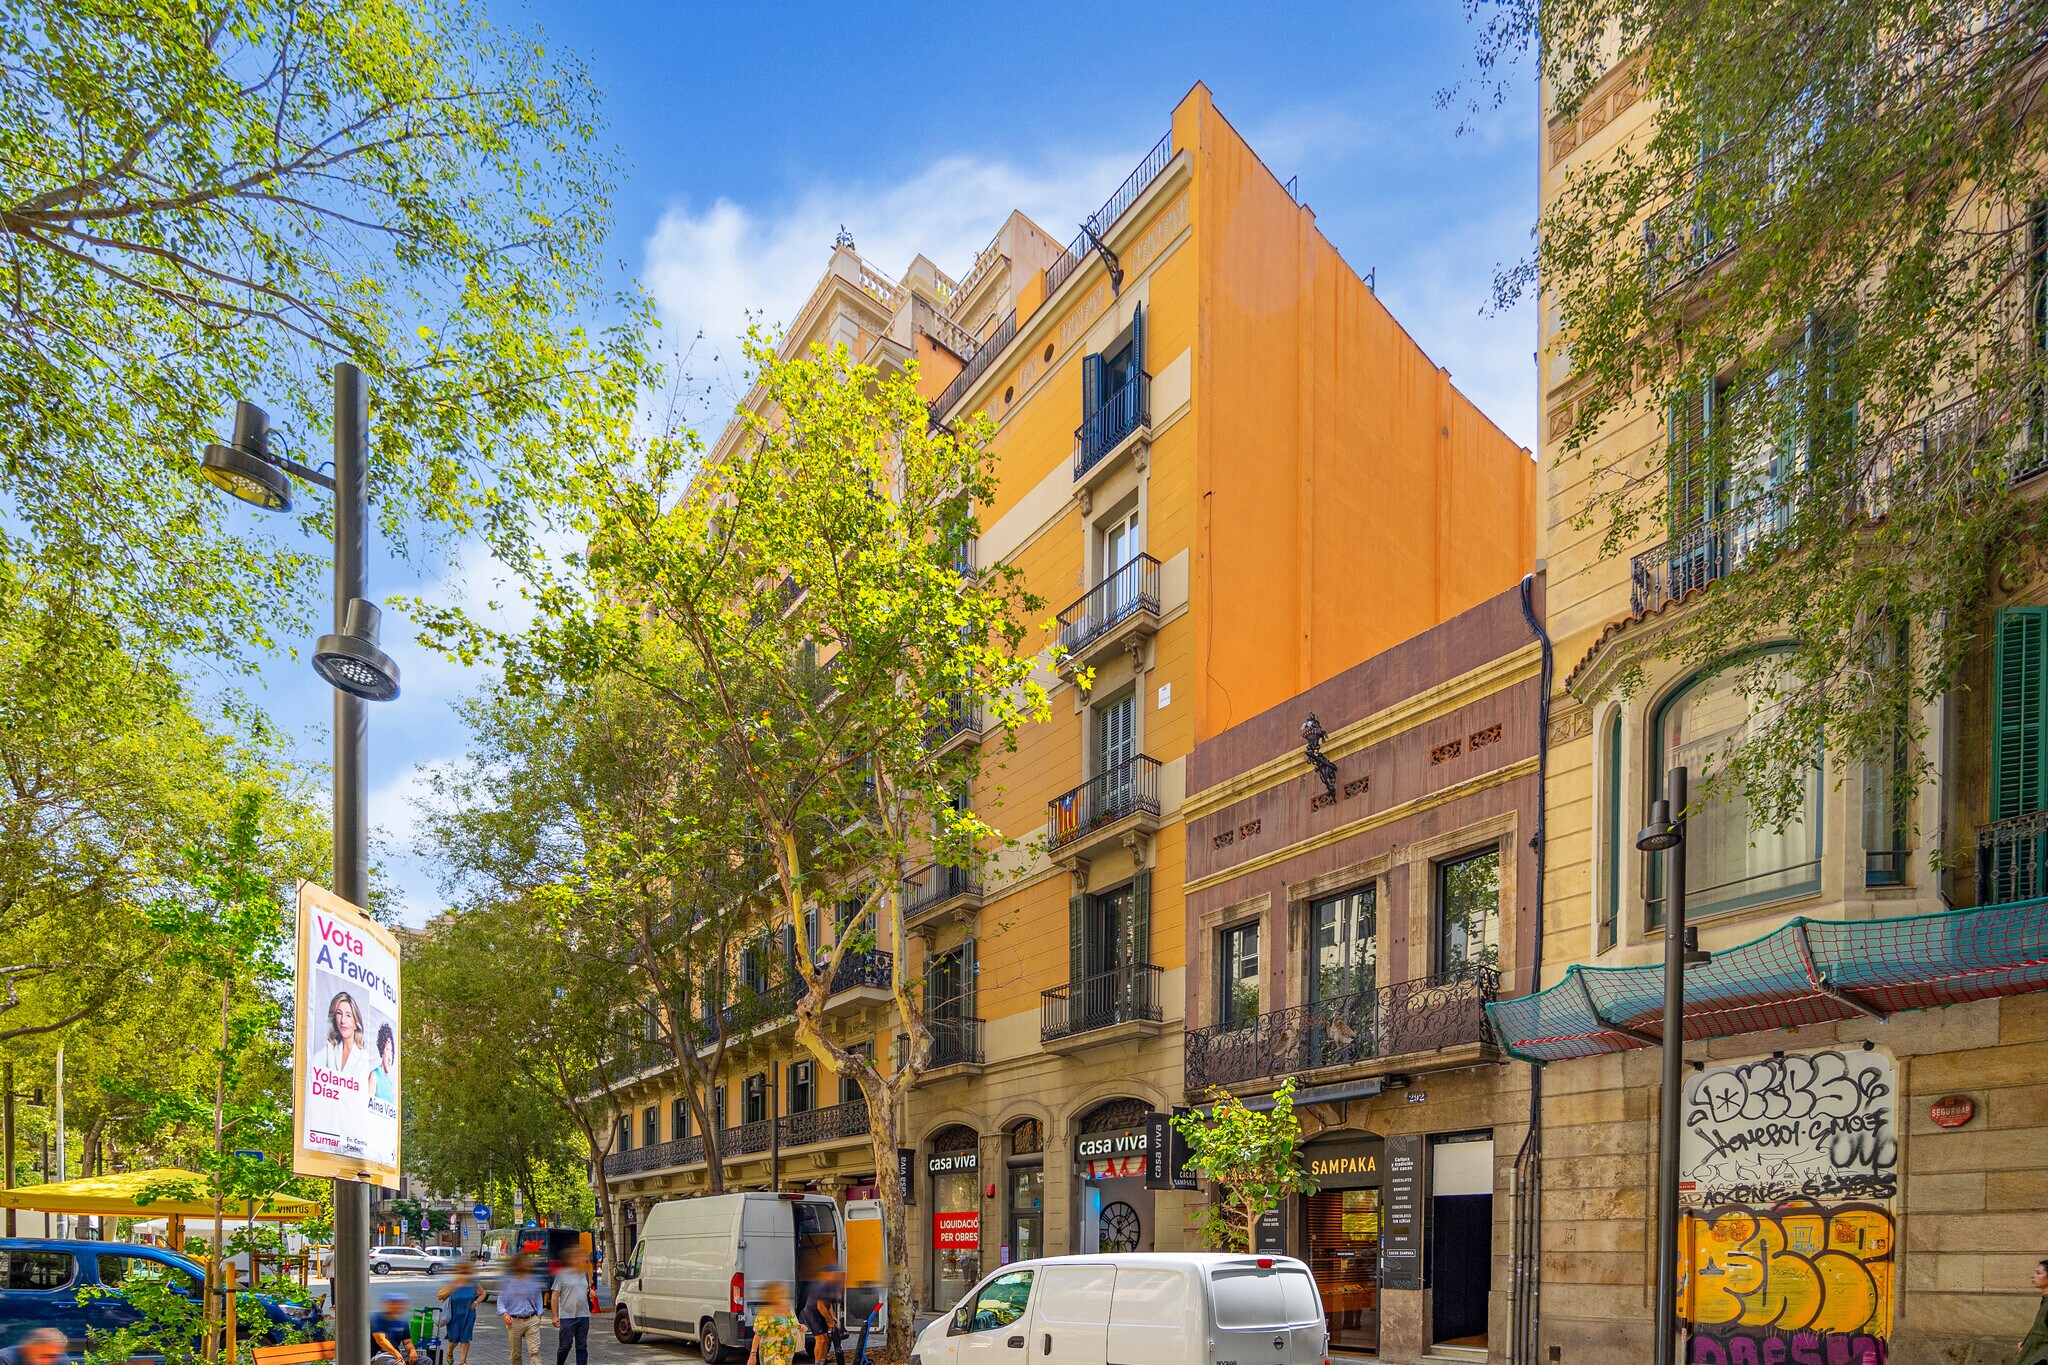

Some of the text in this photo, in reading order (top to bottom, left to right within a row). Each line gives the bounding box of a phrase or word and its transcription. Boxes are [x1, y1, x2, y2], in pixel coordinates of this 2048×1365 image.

[317, 915, 363, 957] Vota
[316, 944, 396, 1004] A favor teu
[313, 1067, 359, 1091] Yolanda
[312, 1081, 339, 1100] Díaz
[368, 1097, 384, 1113] Aina
[384, 1102, 397, 1119] Vida
[1931, 1106, 1970, 1117] SEGURMAP
[309, 1132, 340, 1147] Sumar
[1080, 1130, 1147, 1155] casa viva
[1154, 1124, 1162, 1178] casa viva
[929, 1151, 976, 1172] casa viva
[1311, 1156, 1376, 1175] SAMPAKA
[1179, 1171, 1196, 1179] CACAO
[277, 1205, 310, 1214] VINITUS
[940, 1217, 979, 1229] LIQUIDACIÓ
[940, 1232, 978, 1241] PER OBRES
